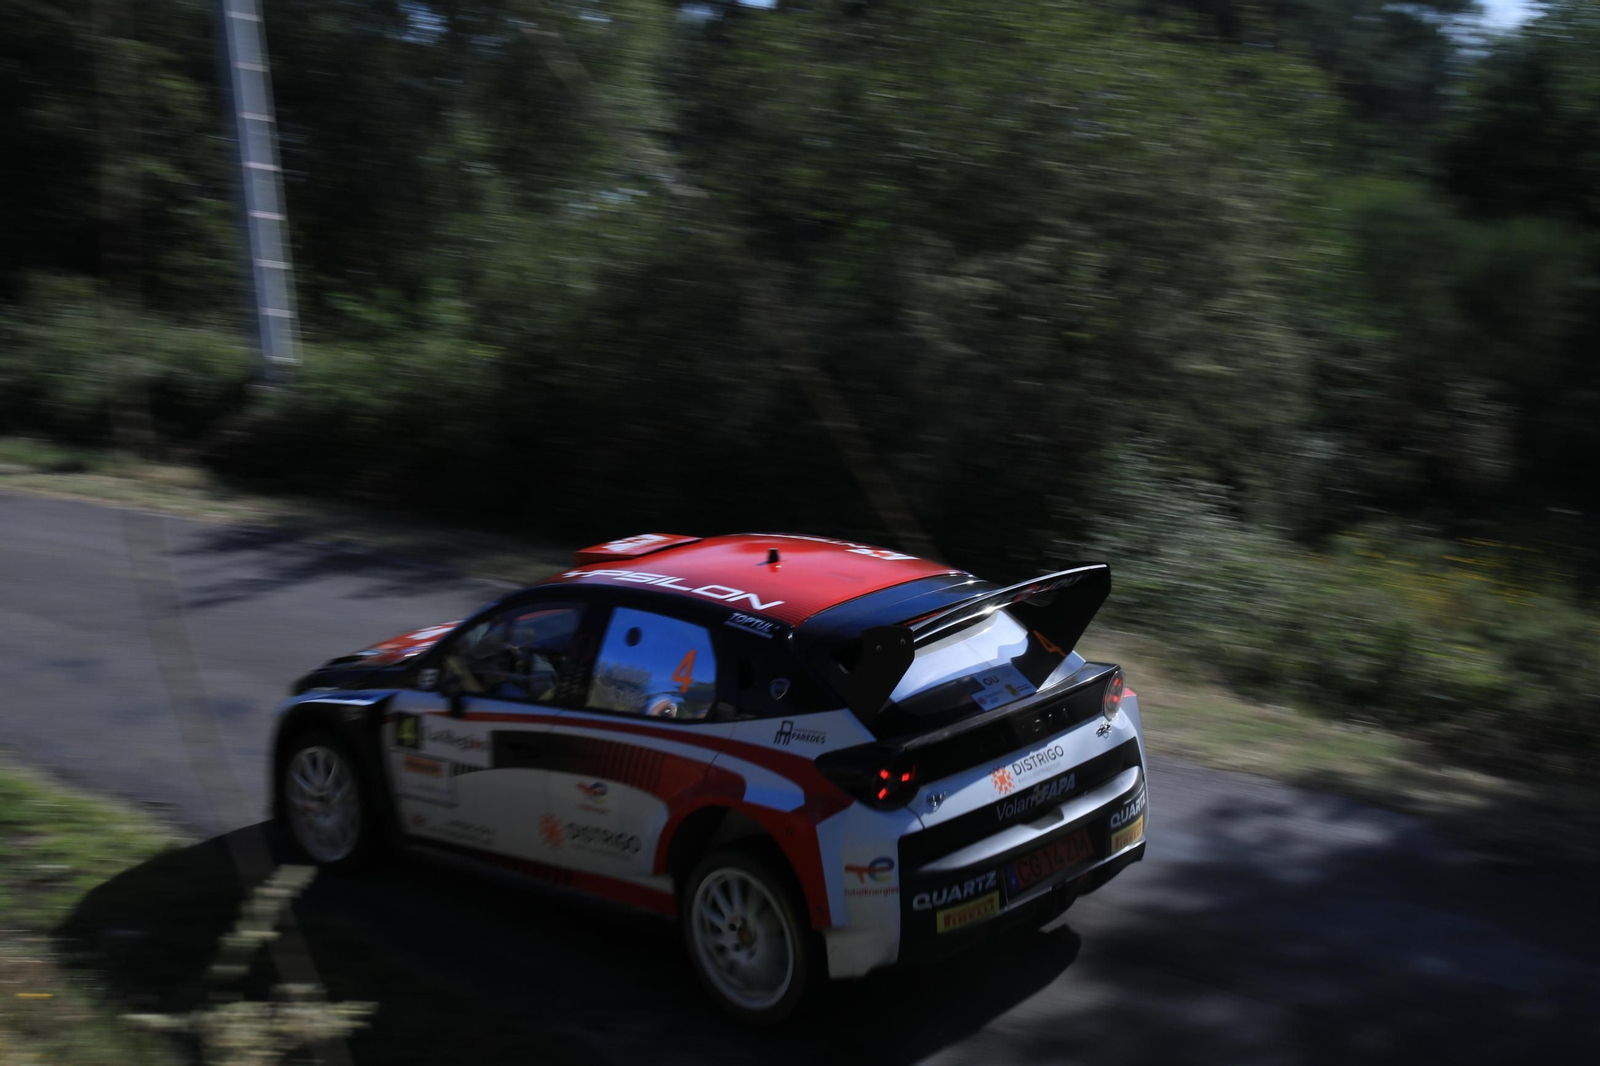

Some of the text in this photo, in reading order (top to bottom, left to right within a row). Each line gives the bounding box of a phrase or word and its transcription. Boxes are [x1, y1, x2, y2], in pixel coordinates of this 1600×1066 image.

[730, 611, 774, 632] TOPTUL
[671, 649, 698, 694] 4
[397, 716, 418, 747] 4
[791, 732, 826, 745] PAREDES
[1011, 745, 1064, 776] DISTRIGO
[1110, 790, 1146, 829] QUARTZ
[912, 869, 997, 912] QUARTZ
